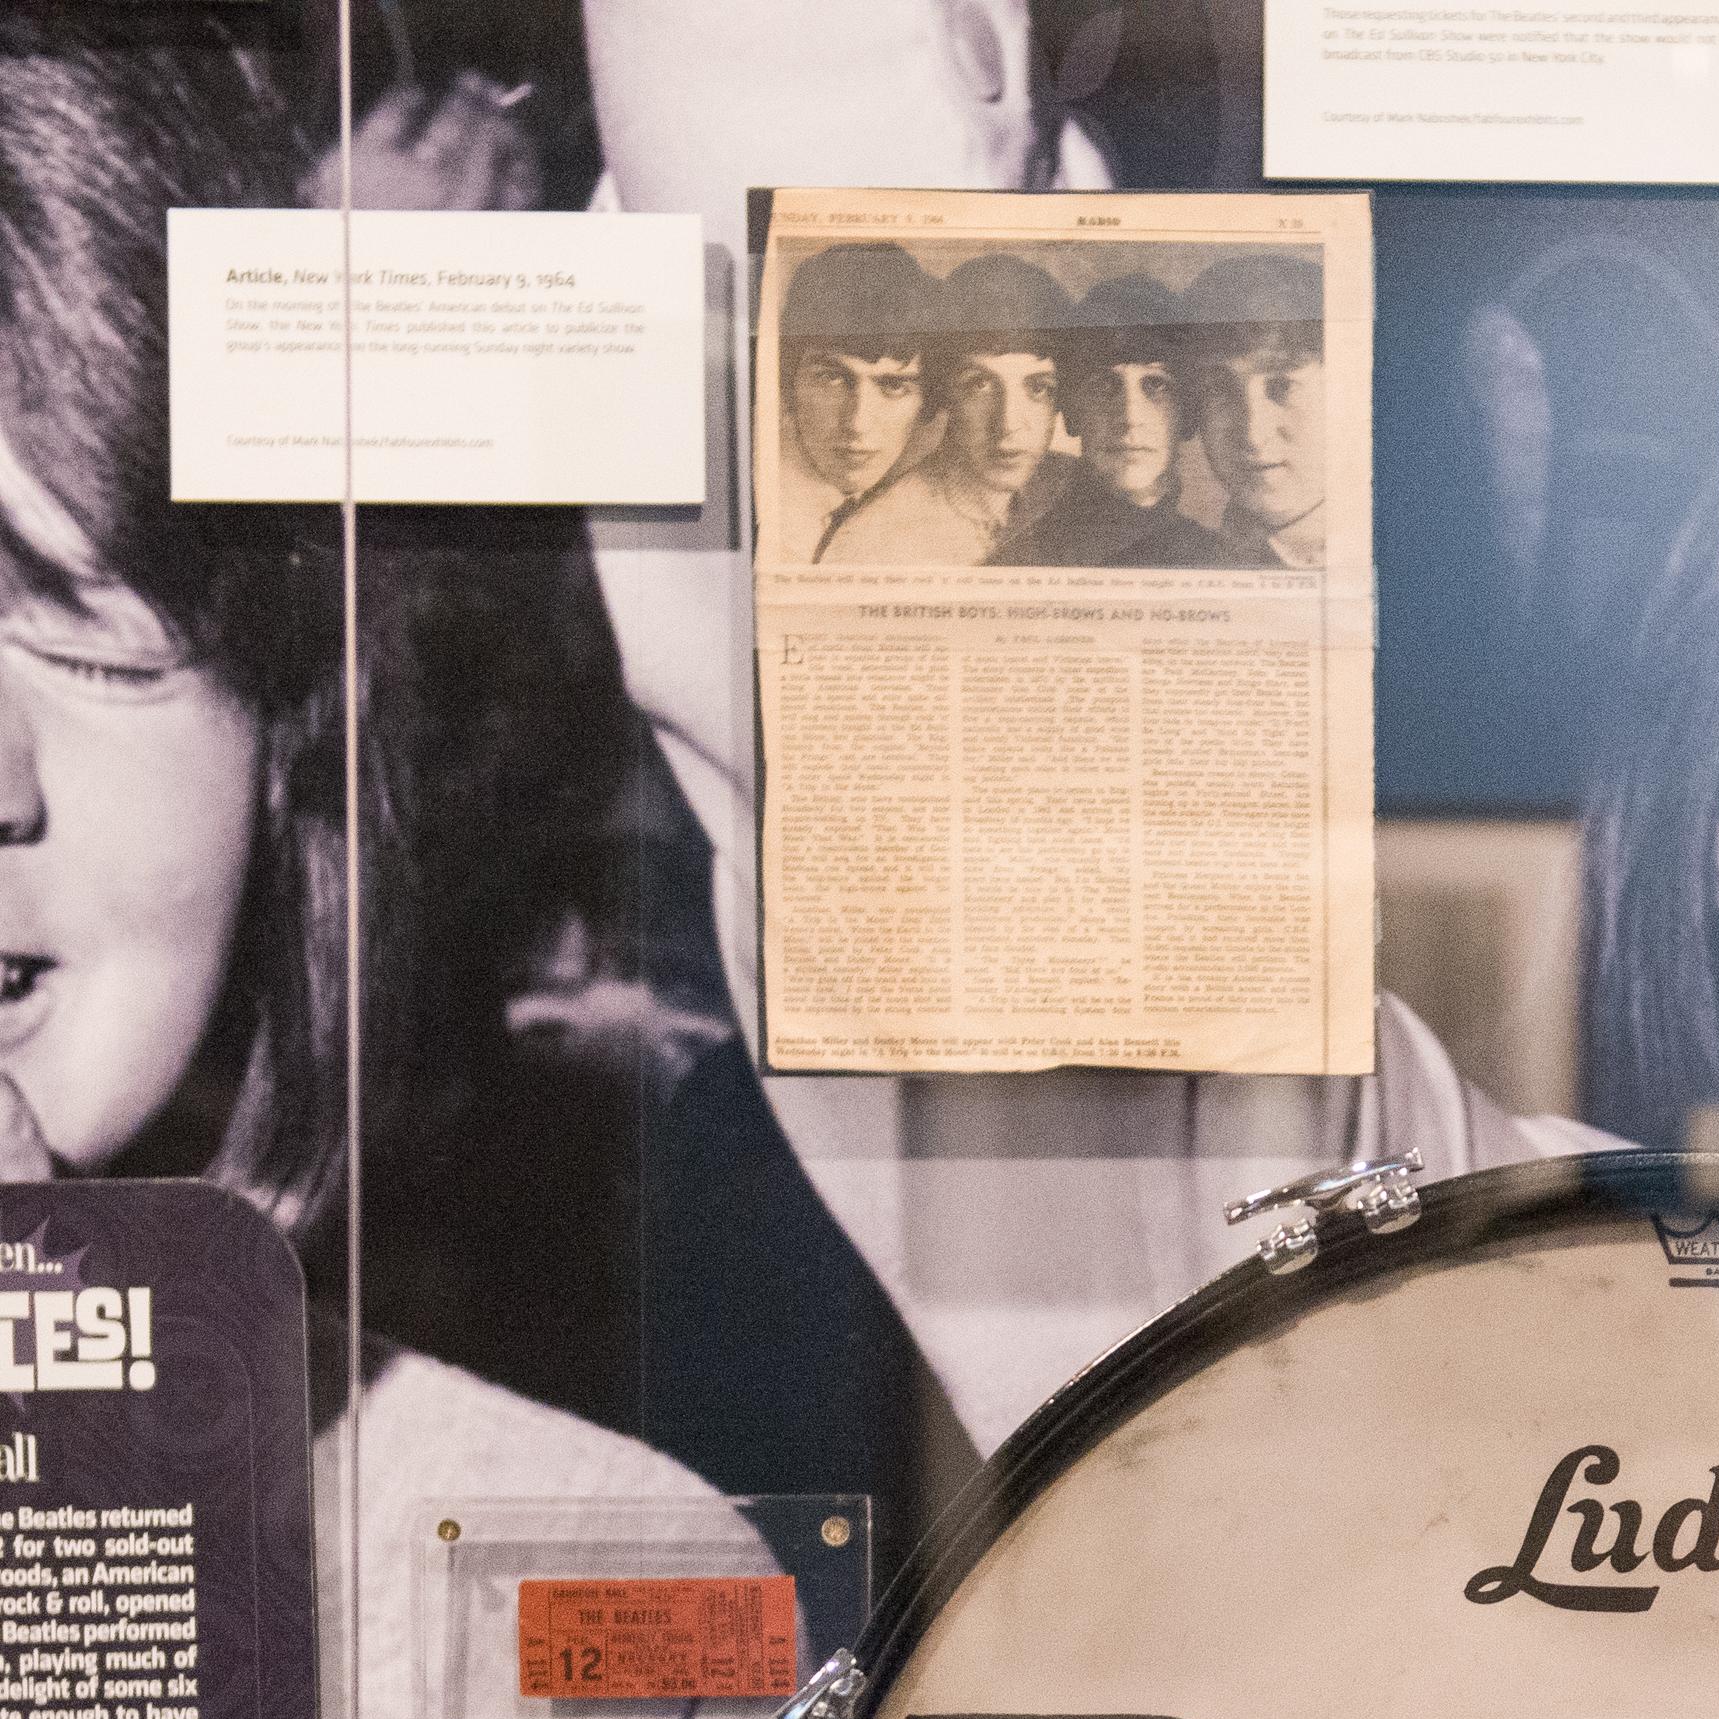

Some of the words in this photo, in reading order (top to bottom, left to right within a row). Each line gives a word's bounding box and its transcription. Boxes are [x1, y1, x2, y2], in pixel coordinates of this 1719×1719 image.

[225, 267, 288, 286] Article,
[292, 269, 329, 285] New
[380, 269, 432, 287] Times,
[437, 270, 512, 289] February
[515, 273, 530, 290] 9,
[536, 271, 576, 290] 1964
[18, 1506, 97, 1529] Beatles
[101, 1504, 192, 1526] returned
[13, 1534, 45, 1557] for
[54, 1537, 96, 1557] two
[105, 1532, 193, 1555] sold-out
[46, 1592, 63, 1614] &
[69, 1590, 109, 1615] roll,
[116, 1589, 195, 1615] opened
[560, 1647, 602, 1681] 12
